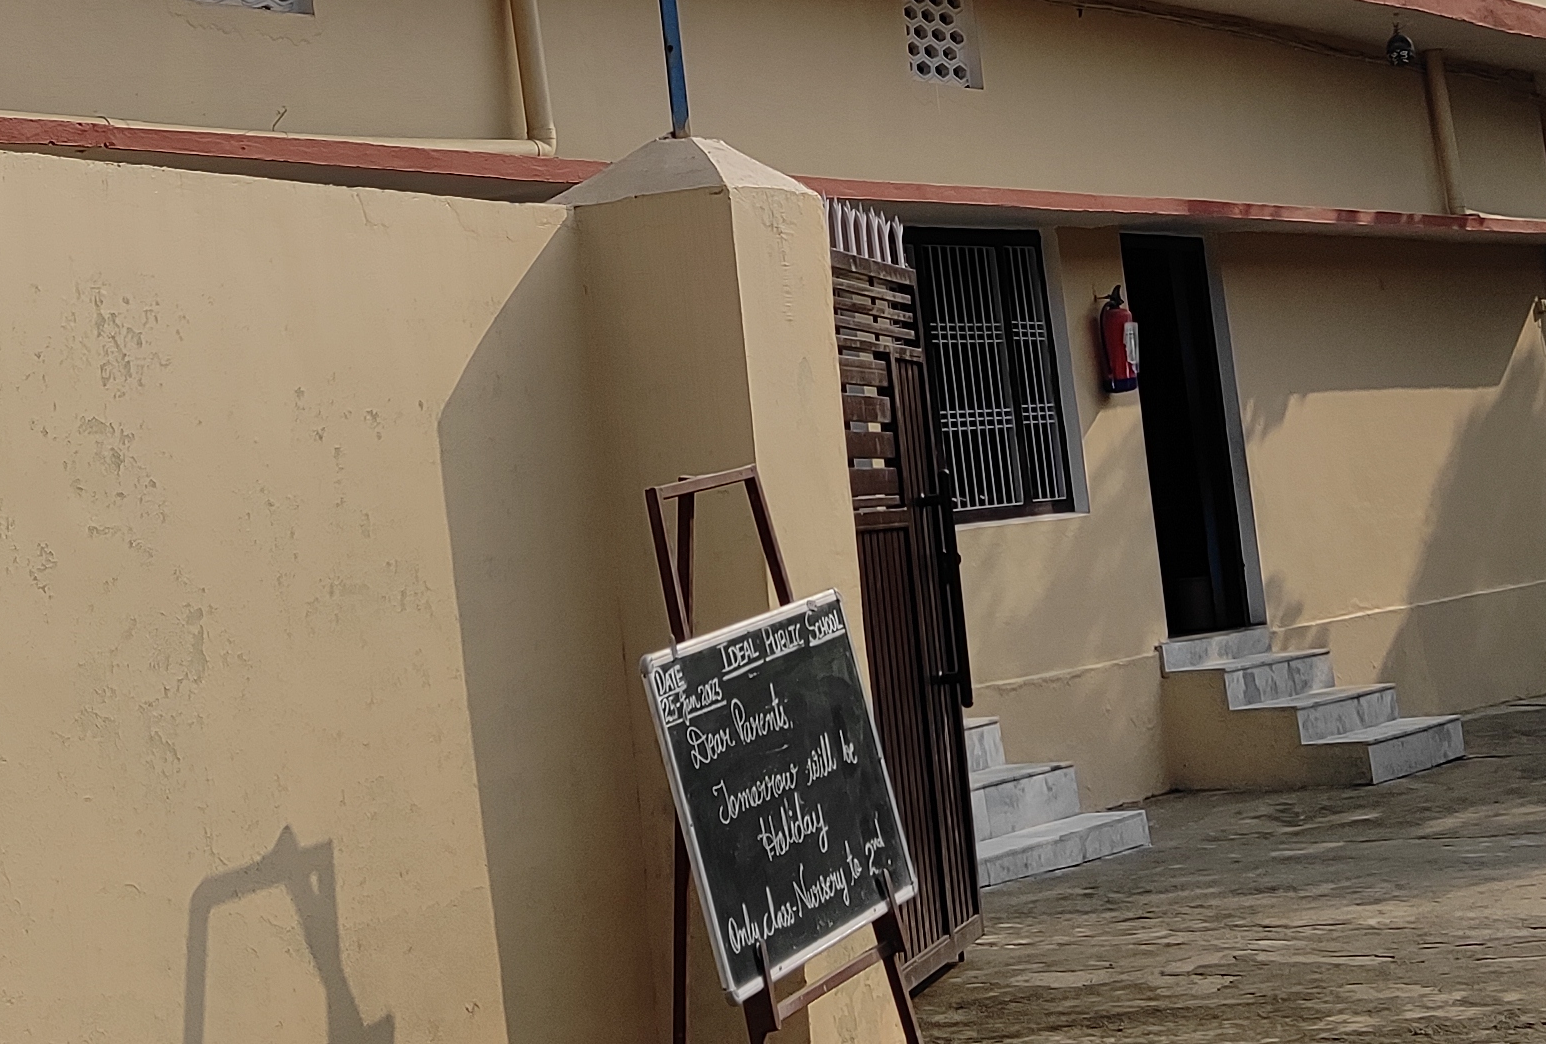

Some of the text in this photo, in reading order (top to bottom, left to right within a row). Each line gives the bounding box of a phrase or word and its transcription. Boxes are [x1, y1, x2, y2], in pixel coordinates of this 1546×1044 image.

[716, 609, 845, 673] IDEAL PUBLIC SCHOOL
[653, 664, 687, 696] DATE
[686, 727, 736, 769] Dear
[712, 729, 858, 824] Tomorrow will be
[757, 792, 829, 861] Holiday
[727, 902, 765, 954] Only
[844, 841, 863, 886] to
